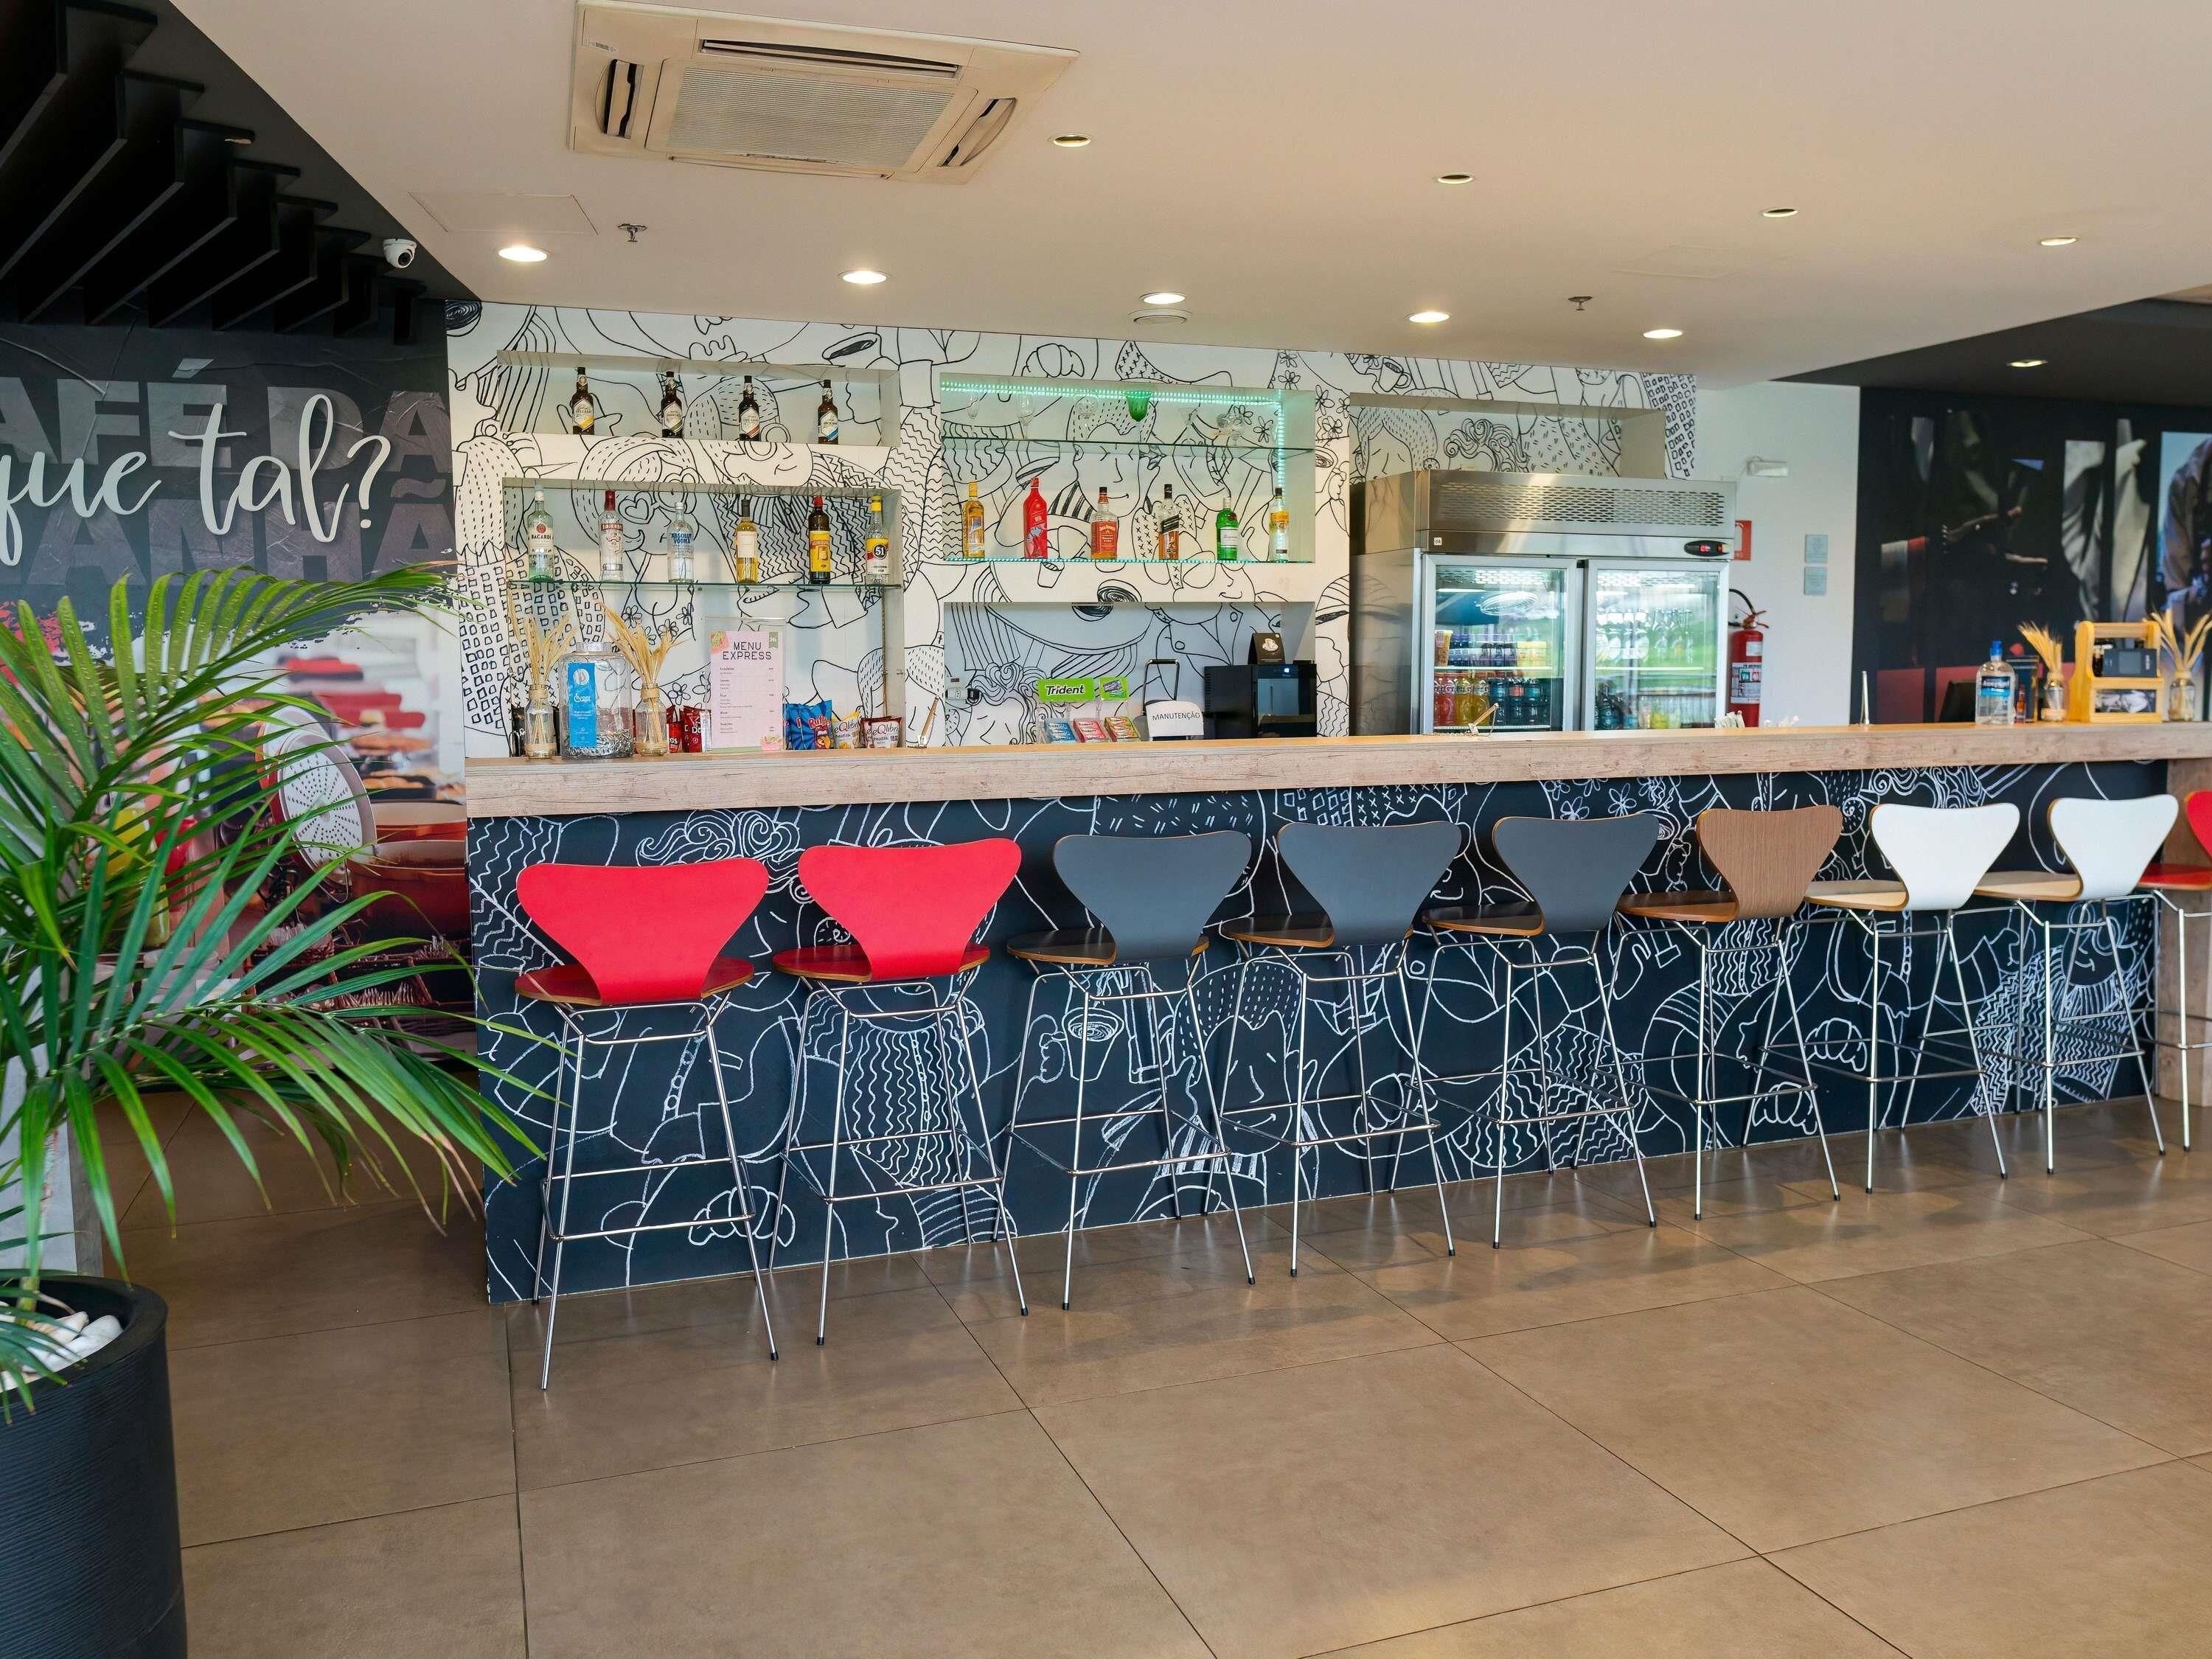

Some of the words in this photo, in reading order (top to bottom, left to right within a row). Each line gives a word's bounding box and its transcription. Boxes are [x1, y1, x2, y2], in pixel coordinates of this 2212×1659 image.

[267, 386, 452, 473] DA
[168, 394, 391, 543] tal?
[0, 479, 457, 585] ANHÃ
[875, 547, 885, 556] 51
[734, 641, 762, 650] MENU
[723, 651, 772, 660] EXPRESS
[1046, 684, 1085, 695] Trident
[1152, 712, 1200, 720] MANUTENÇÃO
